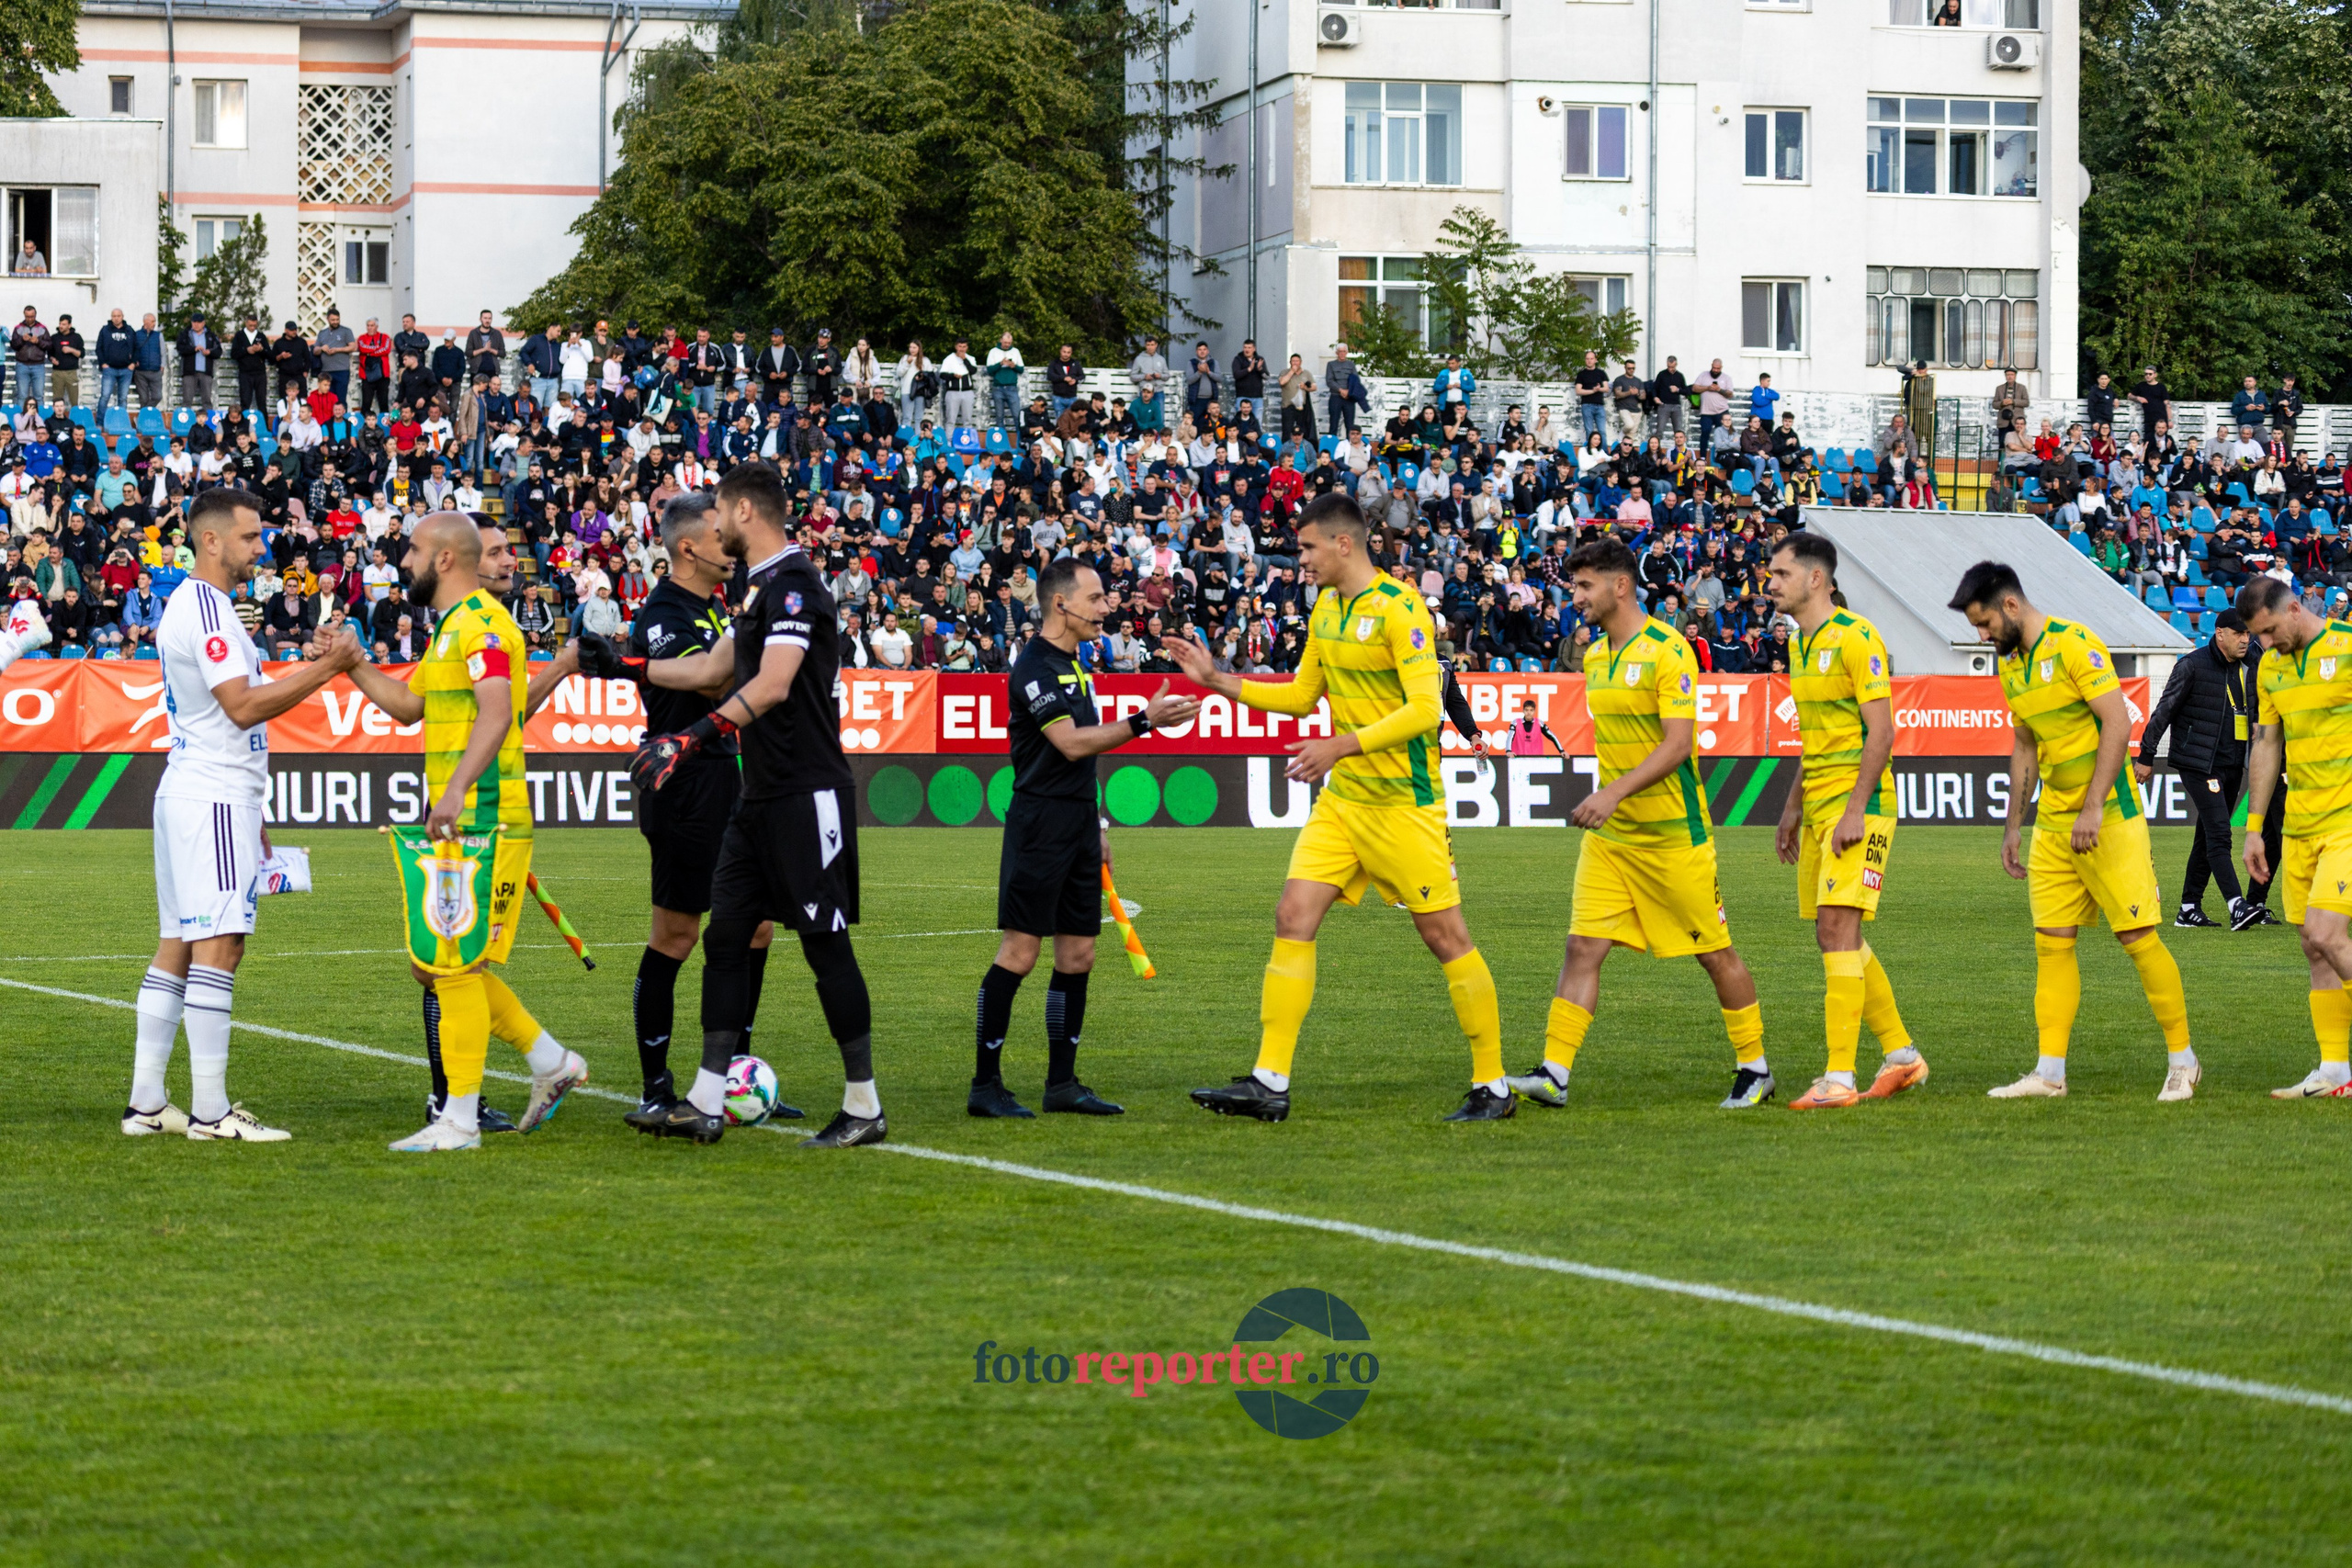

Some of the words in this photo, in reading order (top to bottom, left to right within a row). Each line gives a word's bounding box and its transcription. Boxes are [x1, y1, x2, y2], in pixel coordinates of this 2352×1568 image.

[1894, 709, 2004, 729] CONTINENTS
[1868, 832, 1888, 850] APA
[1866, 848, 1883, 864] DIN
